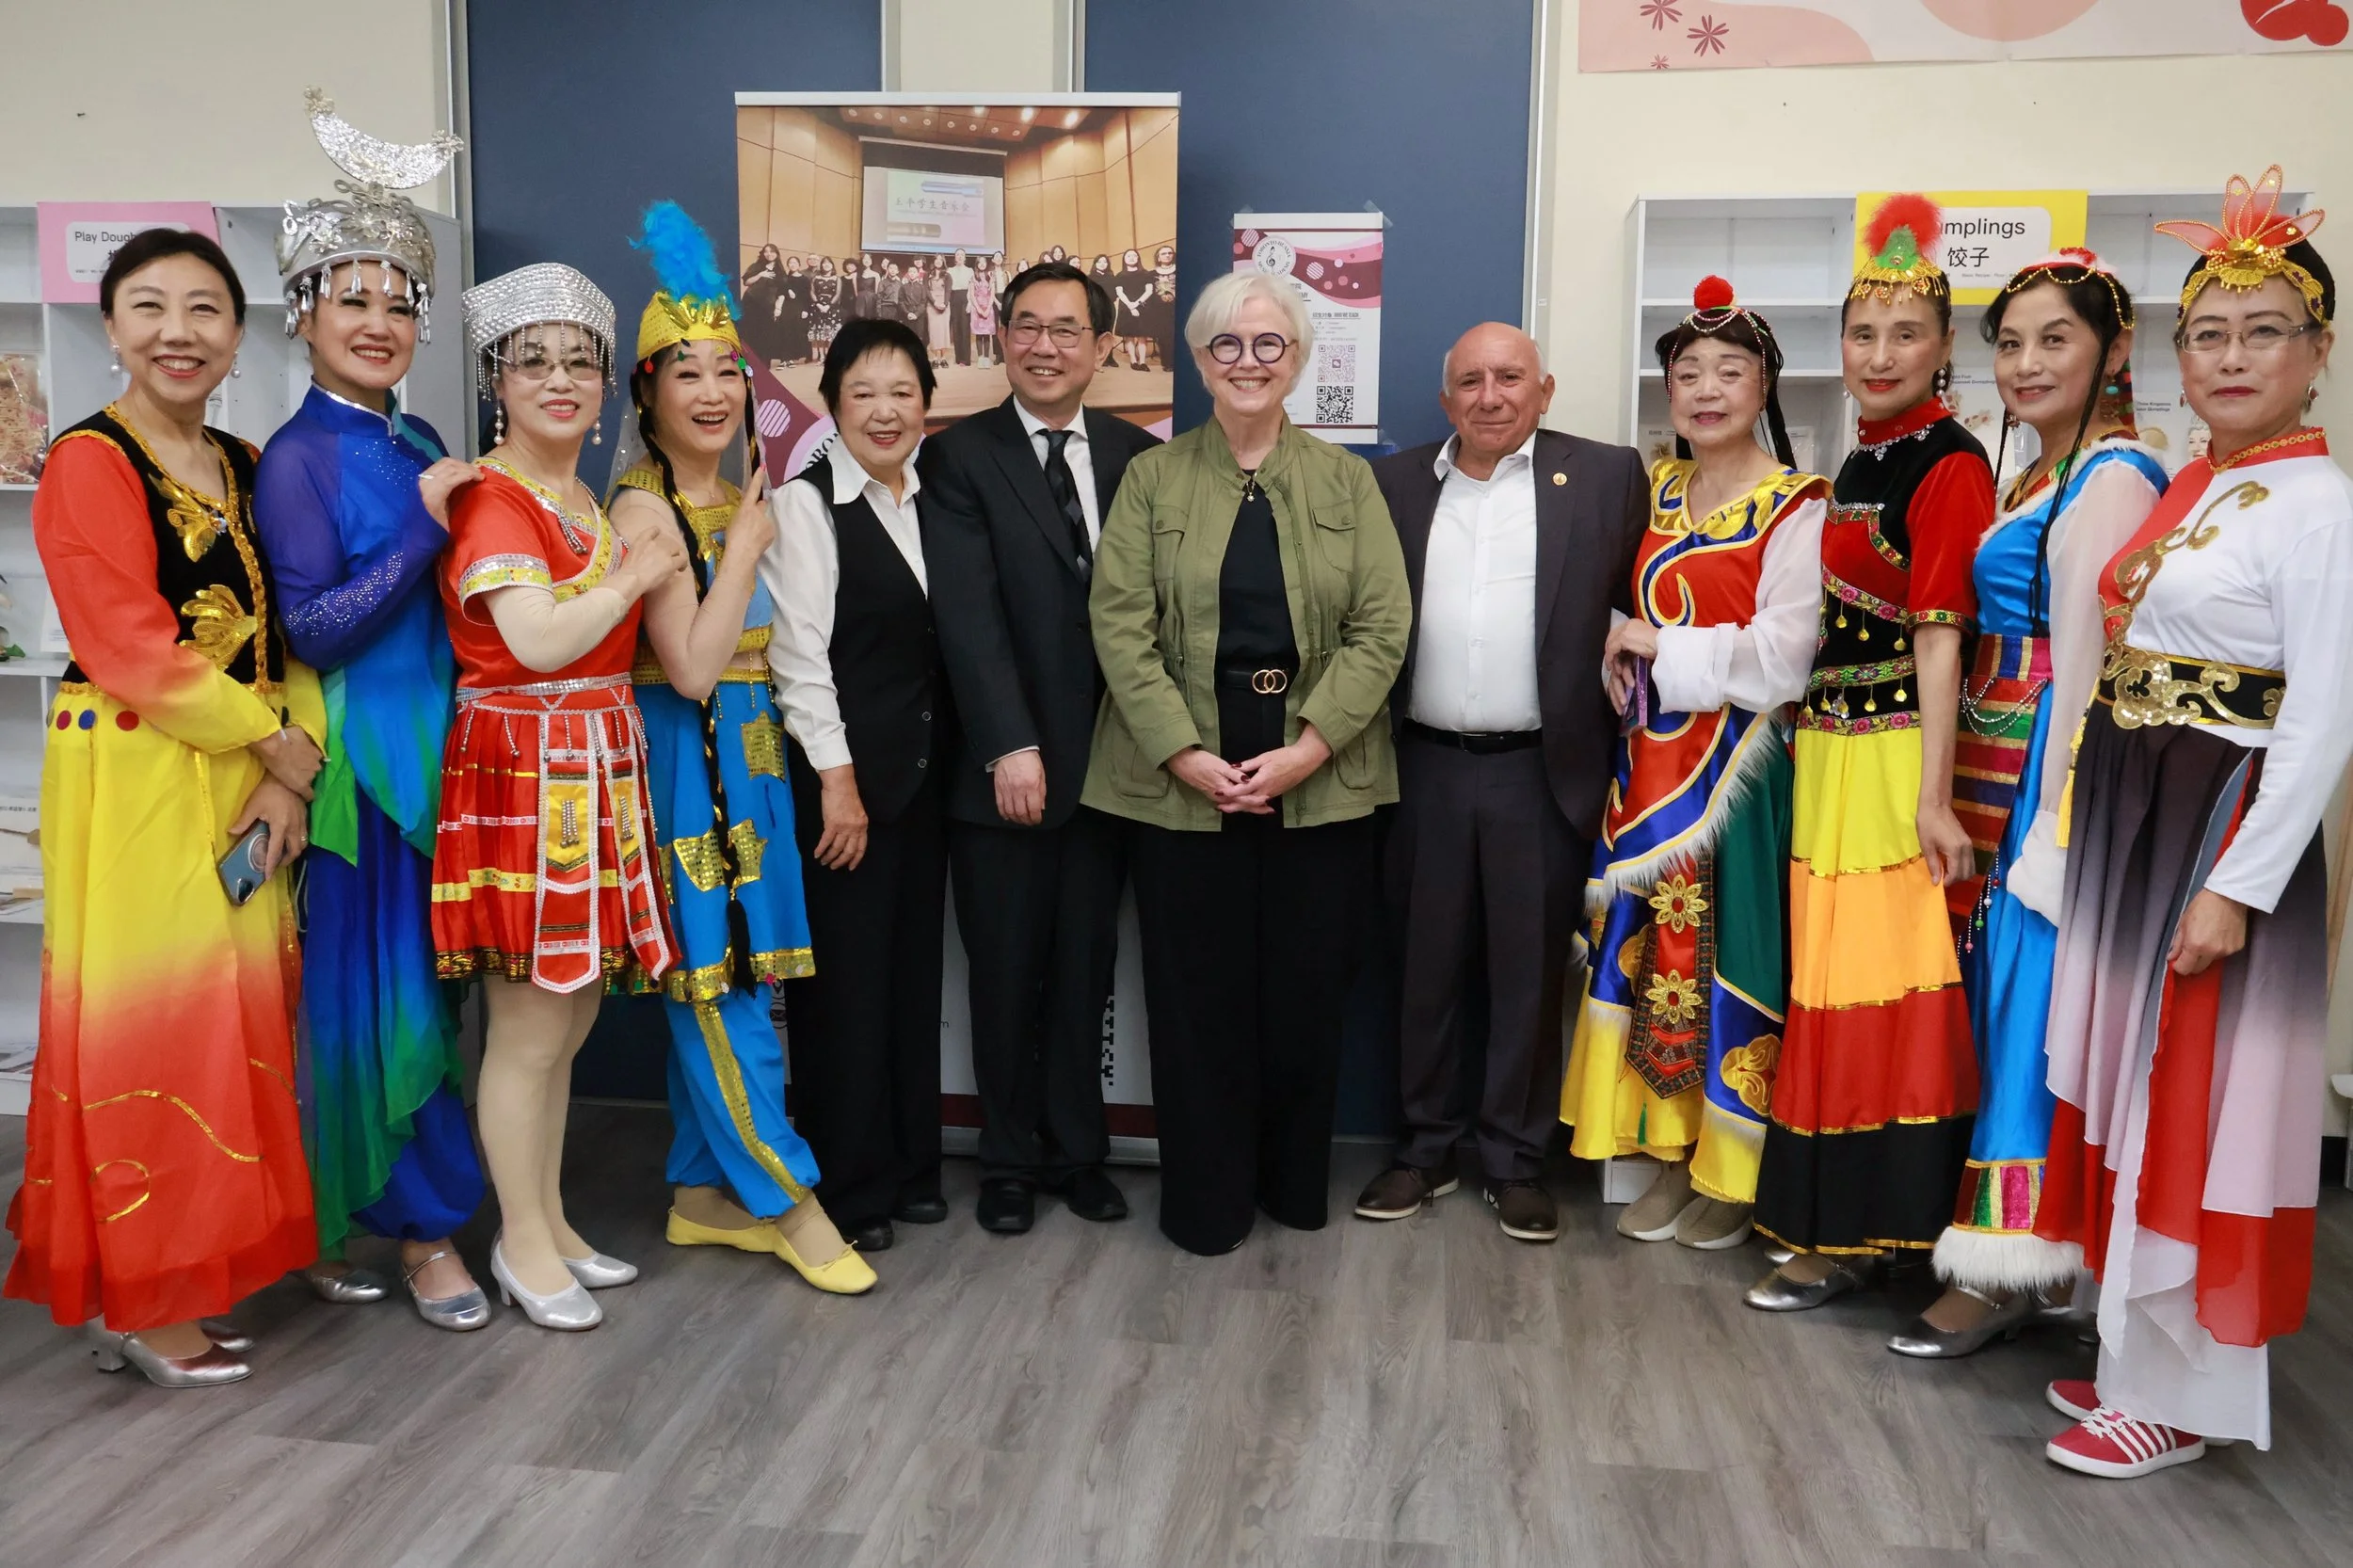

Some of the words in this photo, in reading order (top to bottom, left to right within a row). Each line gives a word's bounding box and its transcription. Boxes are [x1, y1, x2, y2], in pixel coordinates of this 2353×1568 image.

[74, 231, 98, 245] Play
[1941, 217, 2025, 239] mplings
[1947, 247, 1990, 267] 饺子
